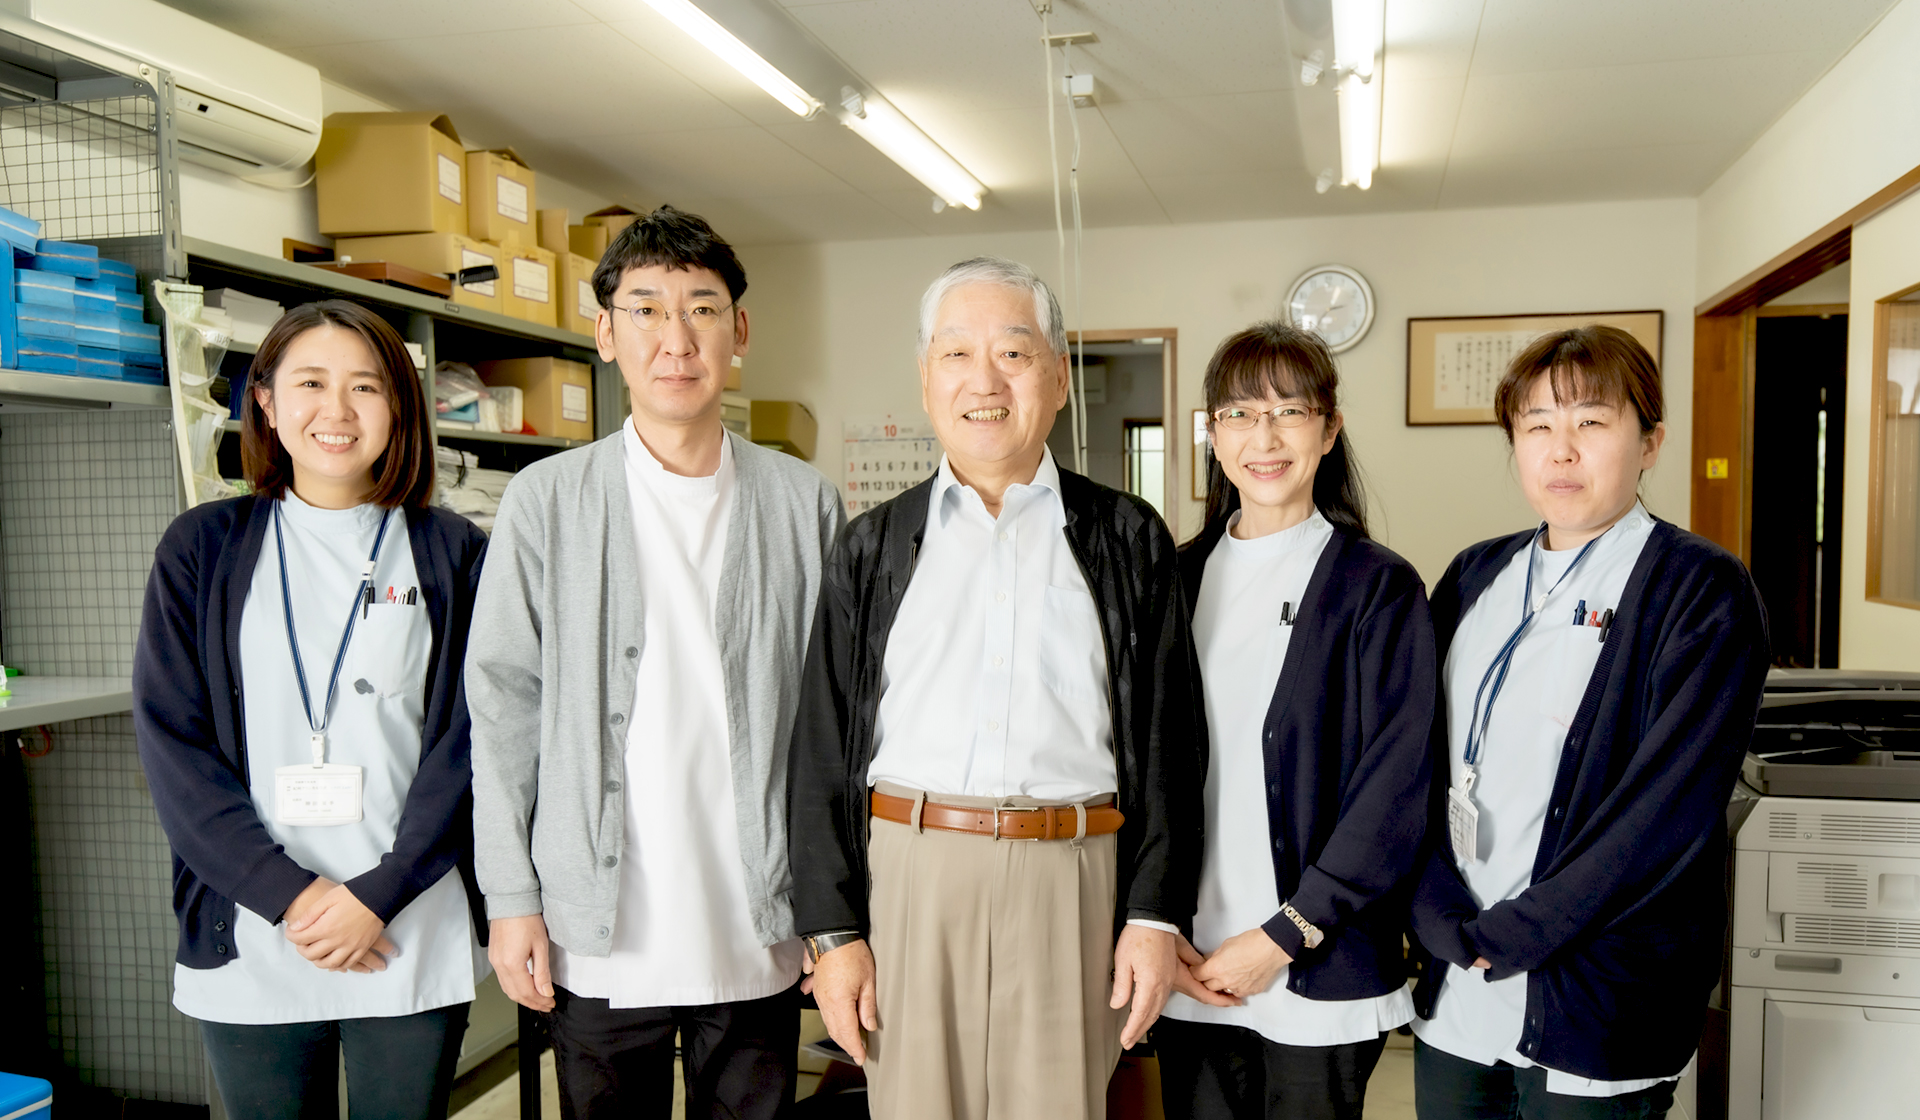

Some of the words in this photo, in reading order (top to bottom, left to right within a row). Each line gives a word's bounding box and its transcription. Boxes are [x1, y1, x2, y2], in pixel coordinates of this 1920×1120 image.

[884, 424, 897, 437] 10
[914, 442, 918, 451] 1
[926, 441, 931, 451] 2
[849, 462, 855, 472] 3
[862, 462, 867, 471] 4
[875, 462, 880, 472] 5
[887, 462, 893, 471] 6
[901, 461, 906, 471] 7
[913, 461, 919, 471] 8
[926, 461, 931, 471] 9
[848, 481, 857, 491] 10
[860, 481, 869, 491] 11
[873, 481, 882, 491] 12
[886, 481, 895, 491] 13
[899, 481, 908, 490] 14
[848, 501, 857, 510] 17
[861, 501, 869, 510] 18
